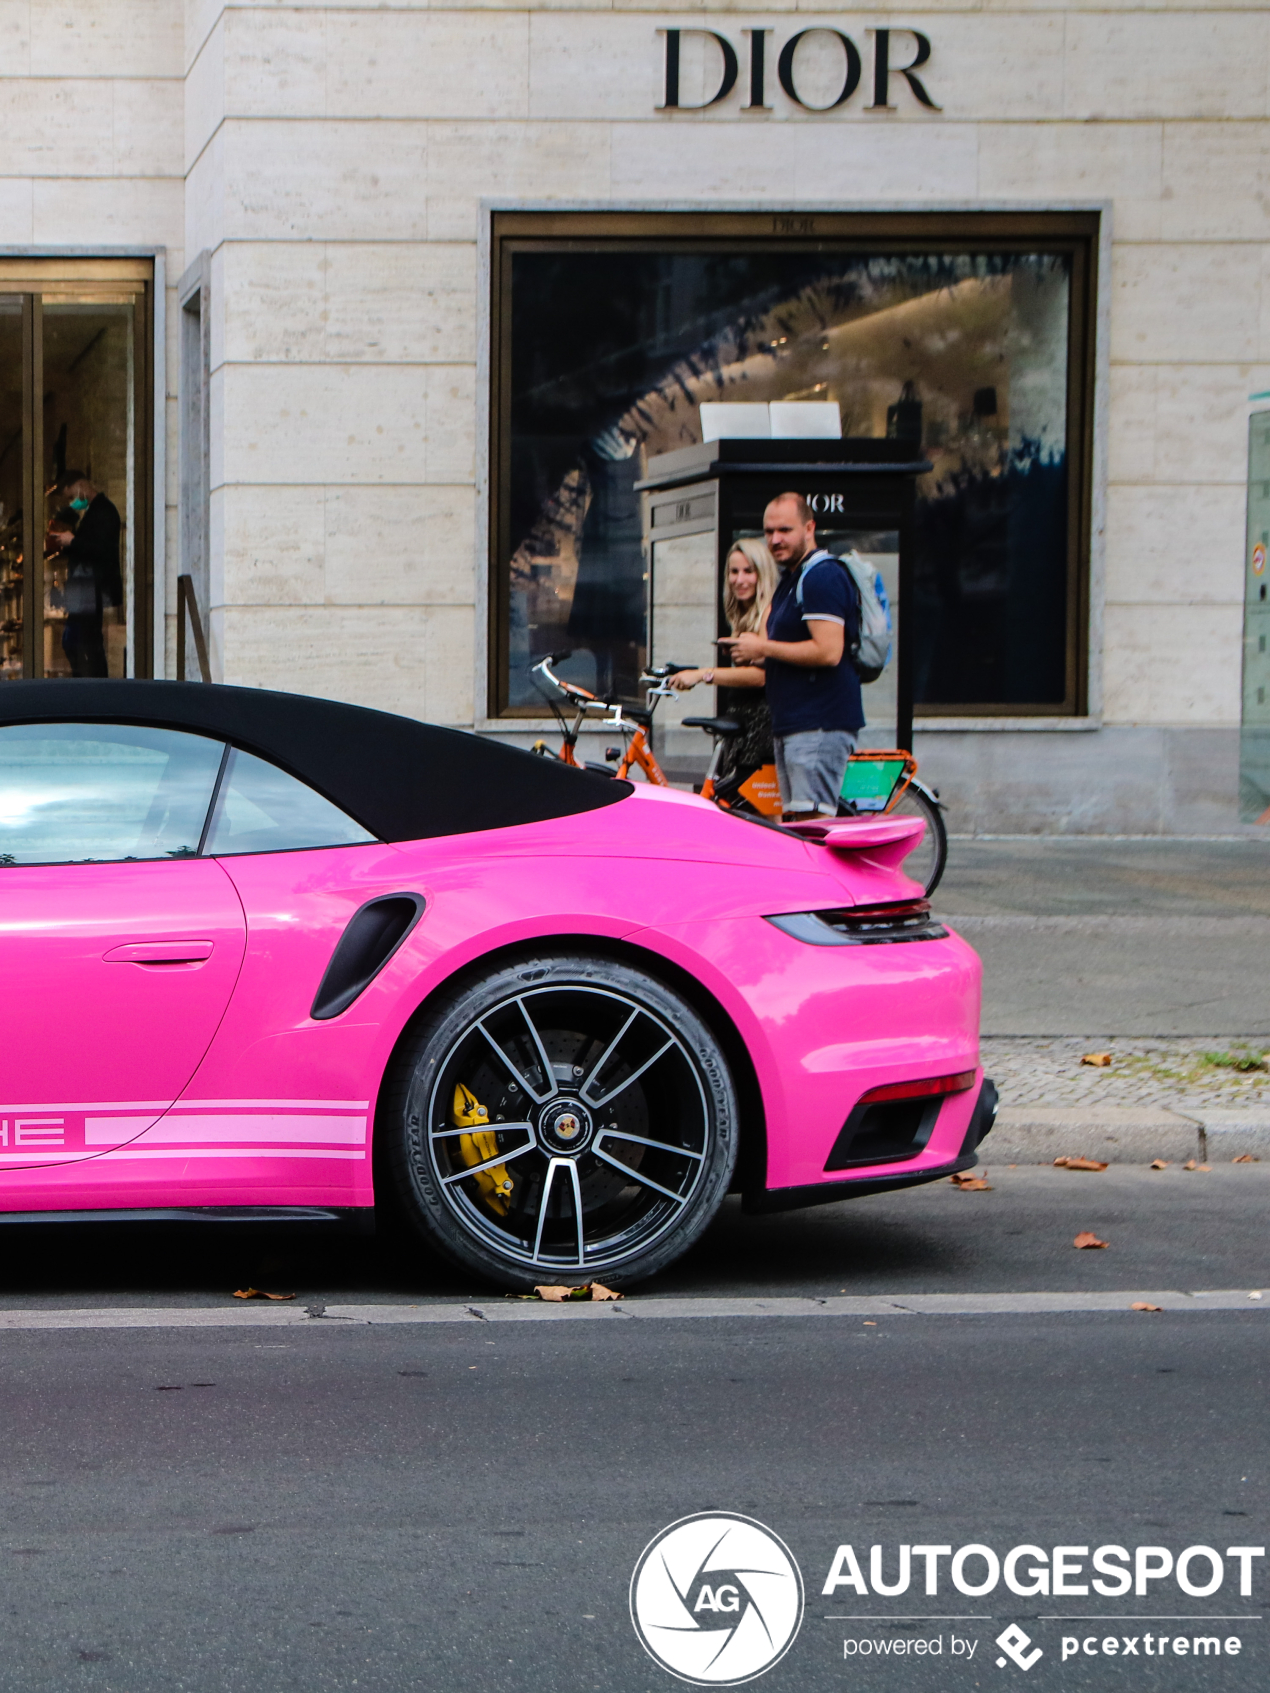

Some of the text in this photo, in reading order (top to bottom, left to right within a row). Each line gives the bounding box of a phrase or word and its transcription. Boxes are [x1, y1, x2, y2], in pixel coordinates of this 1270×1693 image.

[656, 26, 942, 112] DIOR
[806, 493, 845, 513] IOR
[409, 1115, 439, 1207] GOODYEAR
